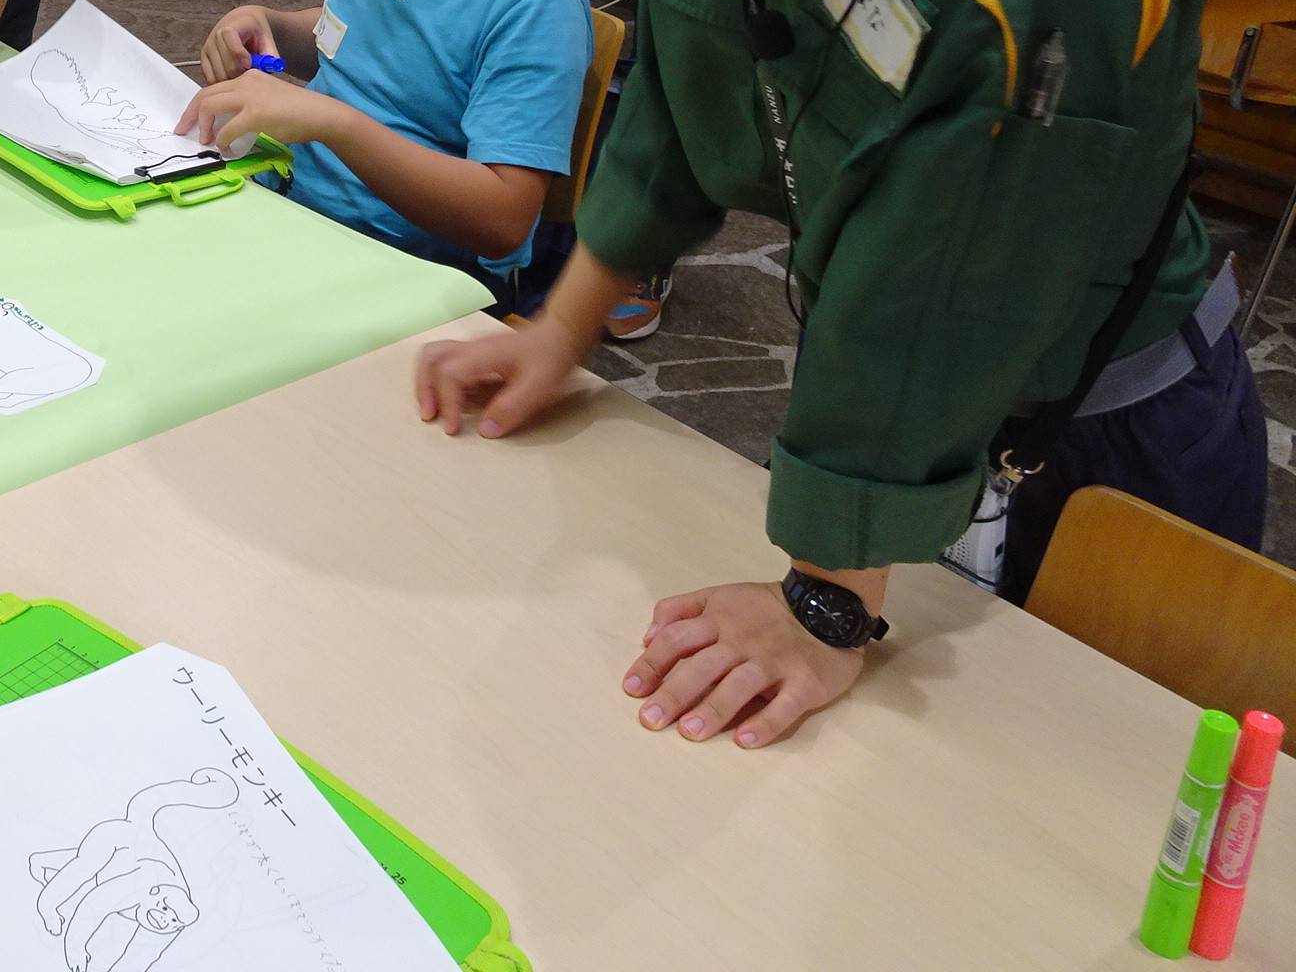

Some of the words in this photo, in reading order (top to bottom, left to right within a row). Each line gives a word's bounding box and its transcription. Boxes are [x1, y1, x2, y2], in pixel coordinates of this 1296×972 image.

[172, 667, 296, 827] ウーリーモンキー
[391, 871, 408, 886] 25
